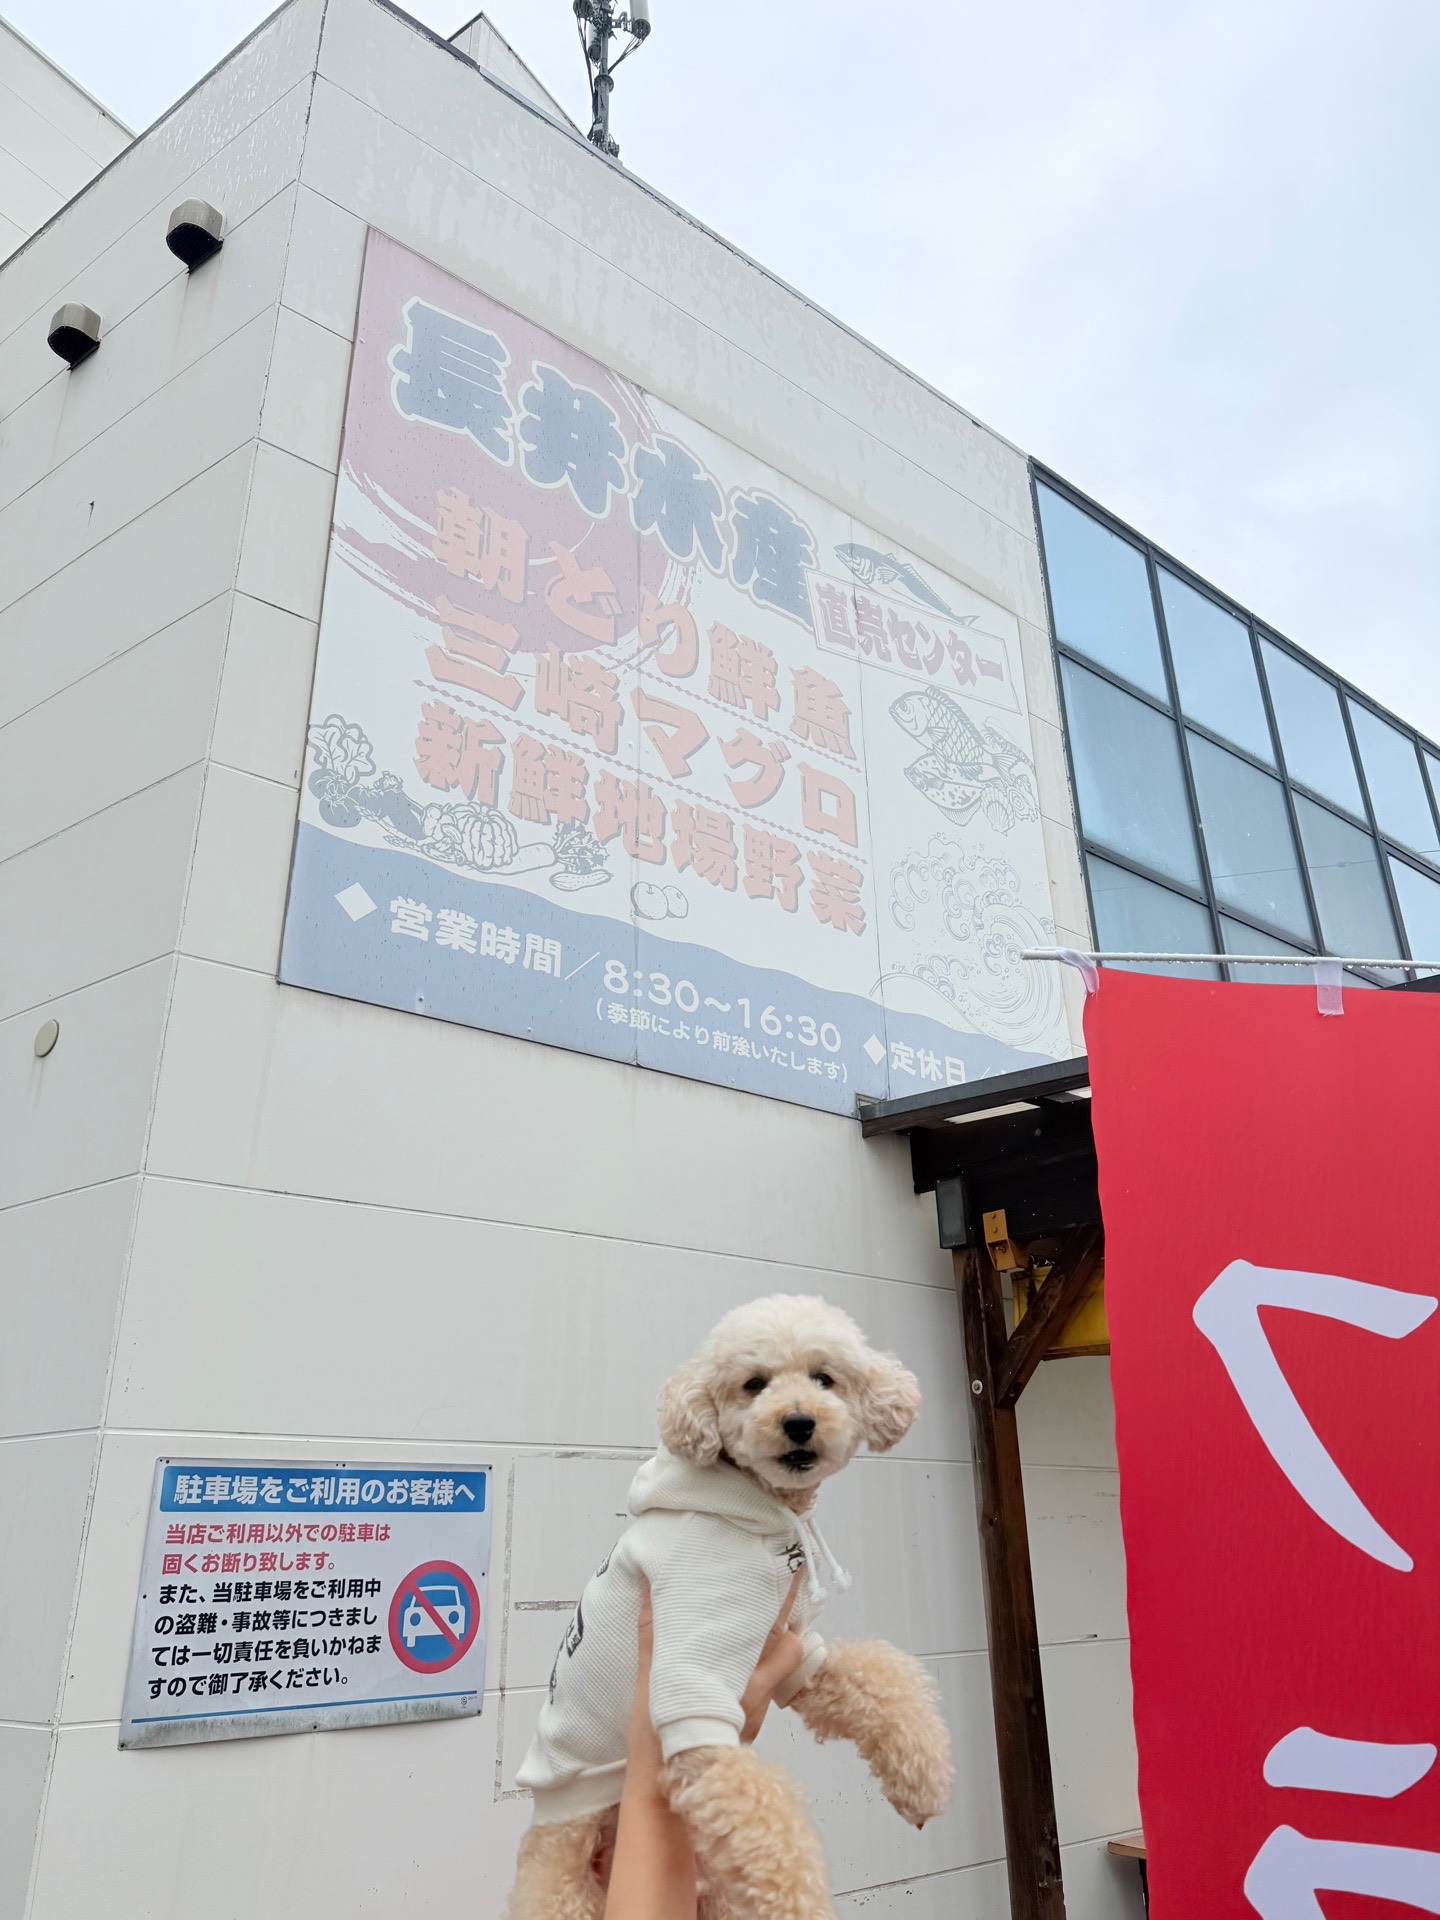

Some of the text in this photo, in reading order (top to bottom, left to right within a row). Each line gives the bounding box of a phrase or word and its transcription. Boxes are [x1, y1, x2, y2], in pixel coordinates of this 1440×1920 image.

[389, 297, 822, 634] 長井水産
[431, 487, 857, 761] 朝とり鮮魚
[815, 582, 1004, 687] 直売センター
[424, 594, 859, 848] 三崎マグロ
[412, 699, 867, 937] 新鮮地場野菜
[173, 1474, 476, 1506] 駐車場をご利用のお客様へ
[164, 1523, 392, 1545] 当店ご利用以外での駐車は
[161, 1551, 336, 1575] 固くお断り致します。
[158, 1578, 382, 1605] また、当駐車場をご利用中
[154, 1608, 378, 1637] の盗難・事故等につきまし
[150, 1635, 383, 1667] ては一切責任を負いかねま
[147, 1667, 350, 1700] すので御了承ください。
